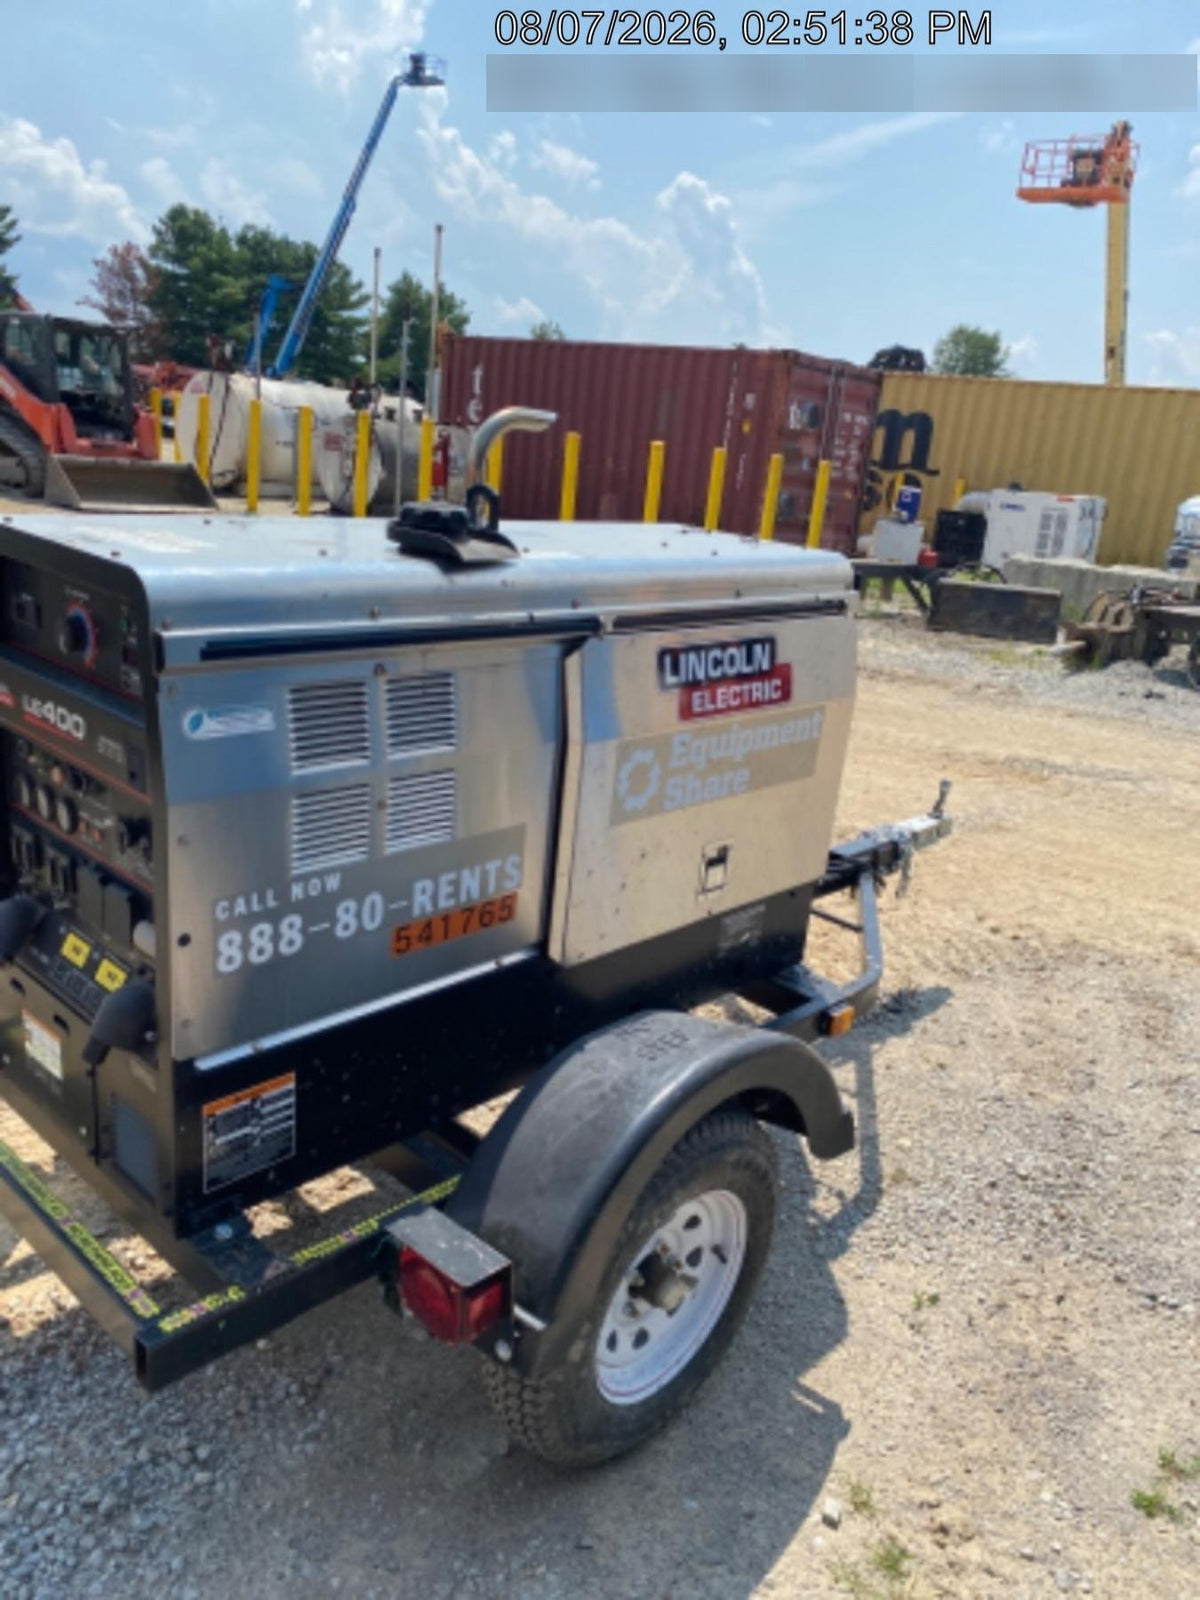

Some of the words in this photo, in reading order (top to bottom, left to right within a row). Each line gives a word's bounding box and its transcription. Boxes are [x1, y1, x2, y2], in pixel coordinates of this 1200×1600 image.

[663, 642, 771, 686] LINCOLN
[691, 678, 783, 713] ELECTRIC
[669, 710, 825, 769] Equipment
[661, 767, 750, 811] Share
[214, 889, 278, 922] CALL
[290, 871, 342, 901] NOW
[215, 853, 523, 974] 888-80-RENTS
[394, 896, 515, 956] 541765
